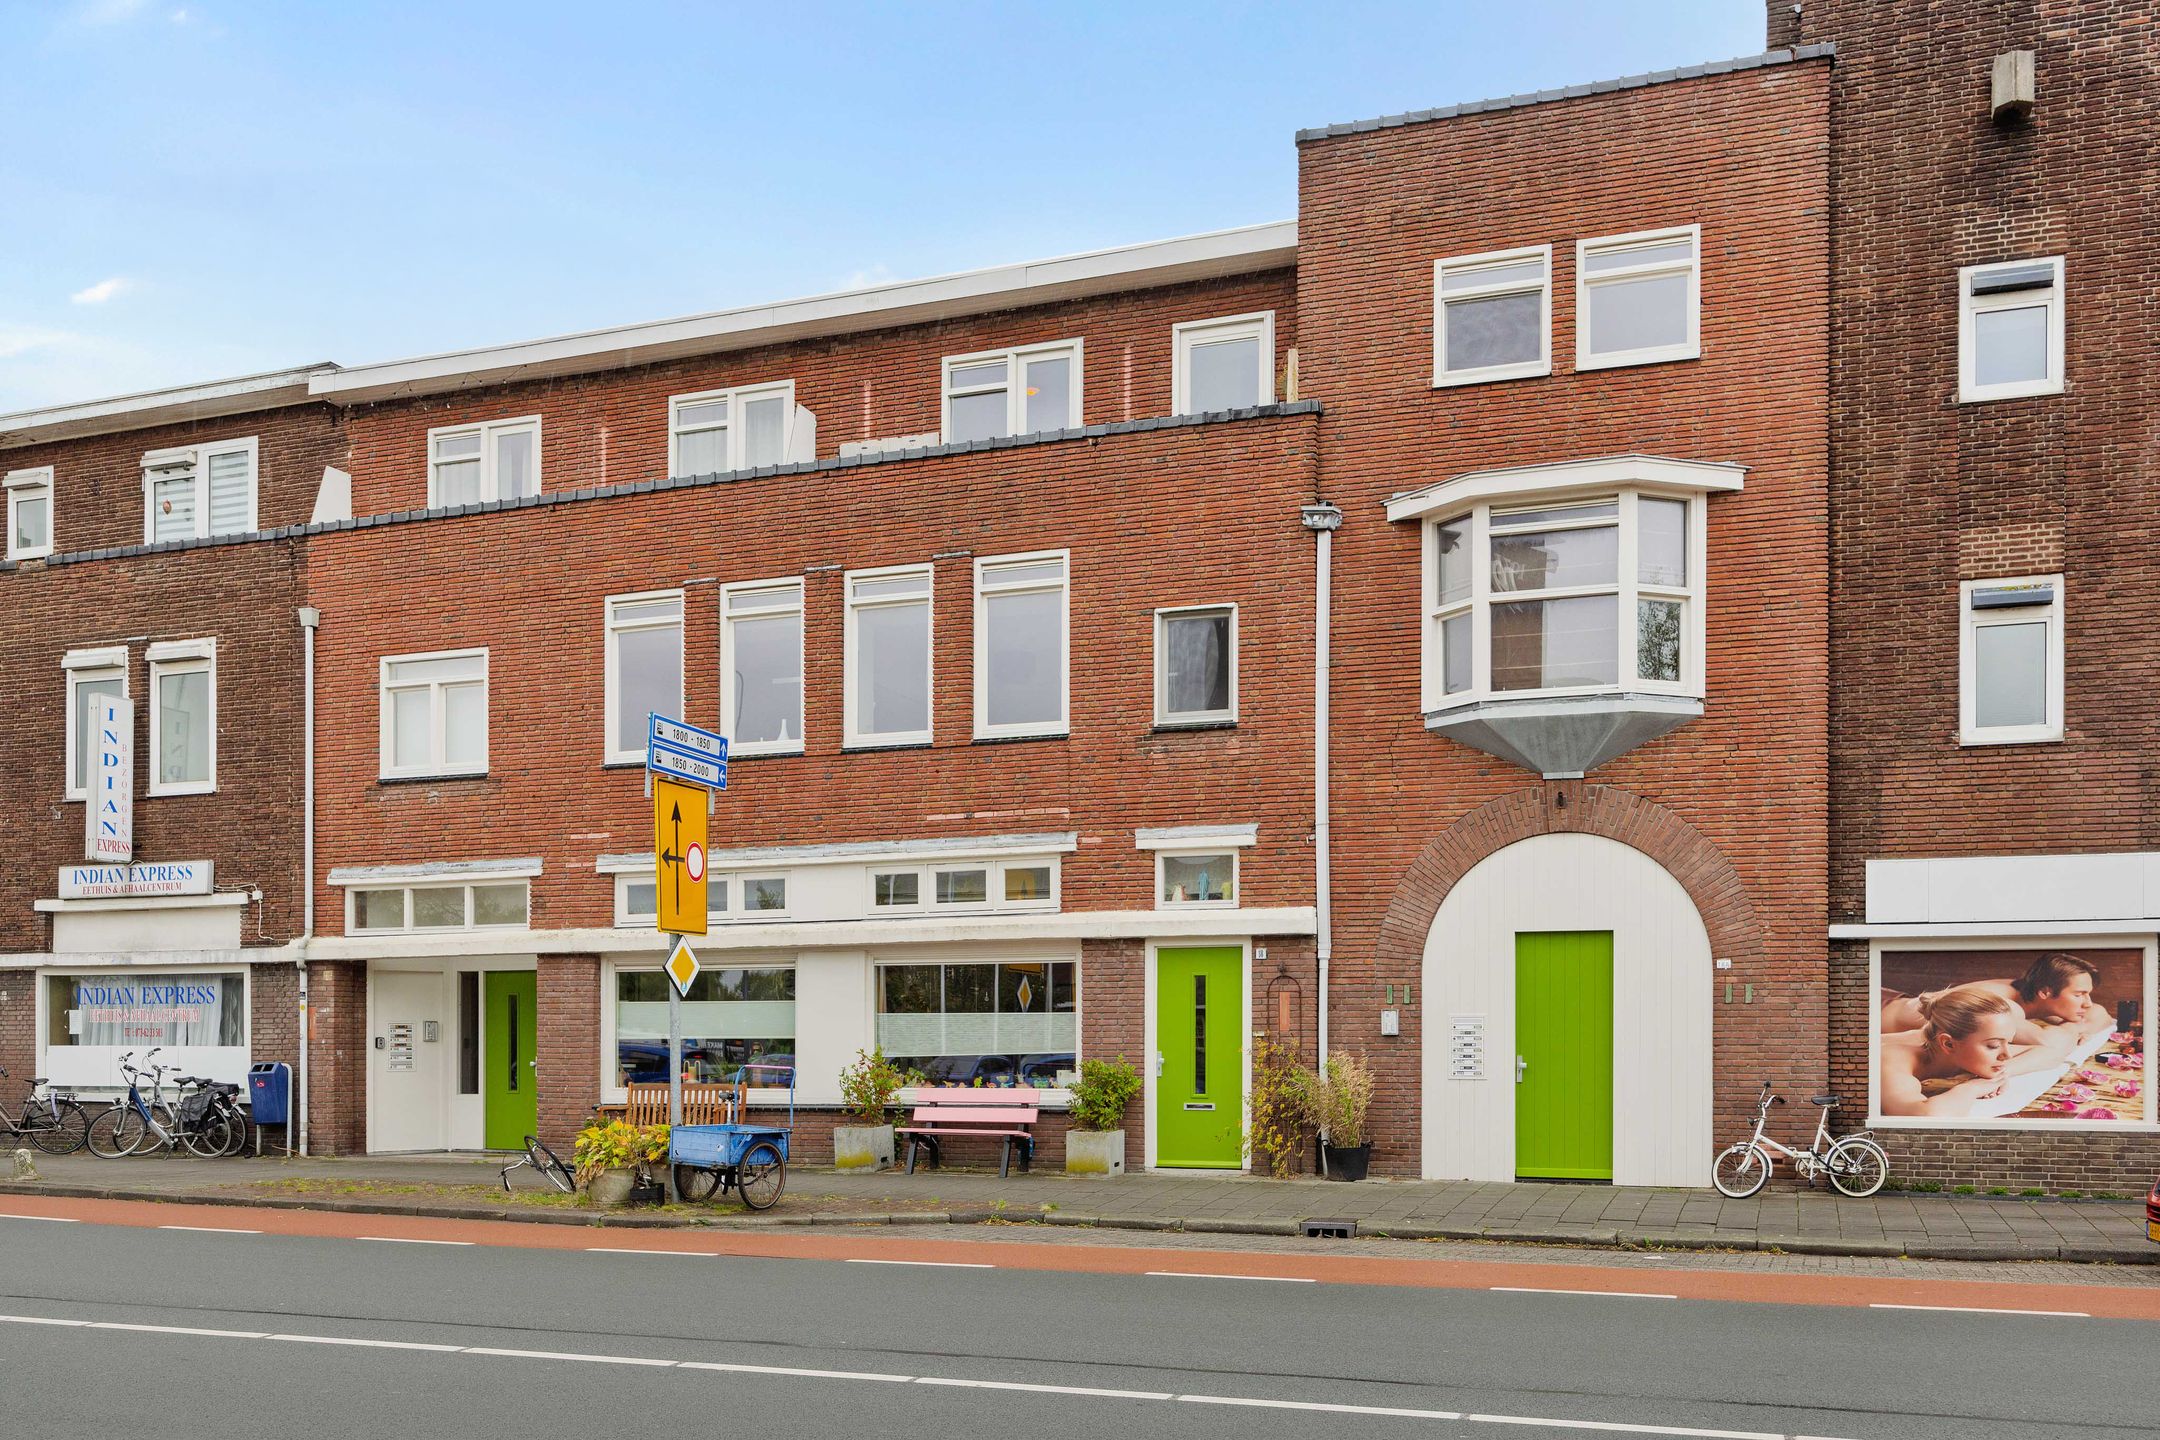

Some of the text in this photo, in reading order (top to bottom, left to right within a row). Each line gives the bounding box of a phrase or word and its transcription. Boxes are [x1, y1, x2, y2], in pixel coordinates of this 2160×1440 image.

[673, 728, 689, 743] 1800
[696, 736, 711, 750] 1850
[101, 707, 119, 837] INDIAN
[672, 756, 687, 771] 1850
[693, 762, 709, 777] 2000
[97, 838, 131, 854] EXPRESS
[74, 864, 193, 885] INDIAN EXPRESS
[82, 884, 112, 896] EETHUIS
[112, 885, 119, 894] &
[77, 985, 216, 1006] INDIAN EXPRESS
